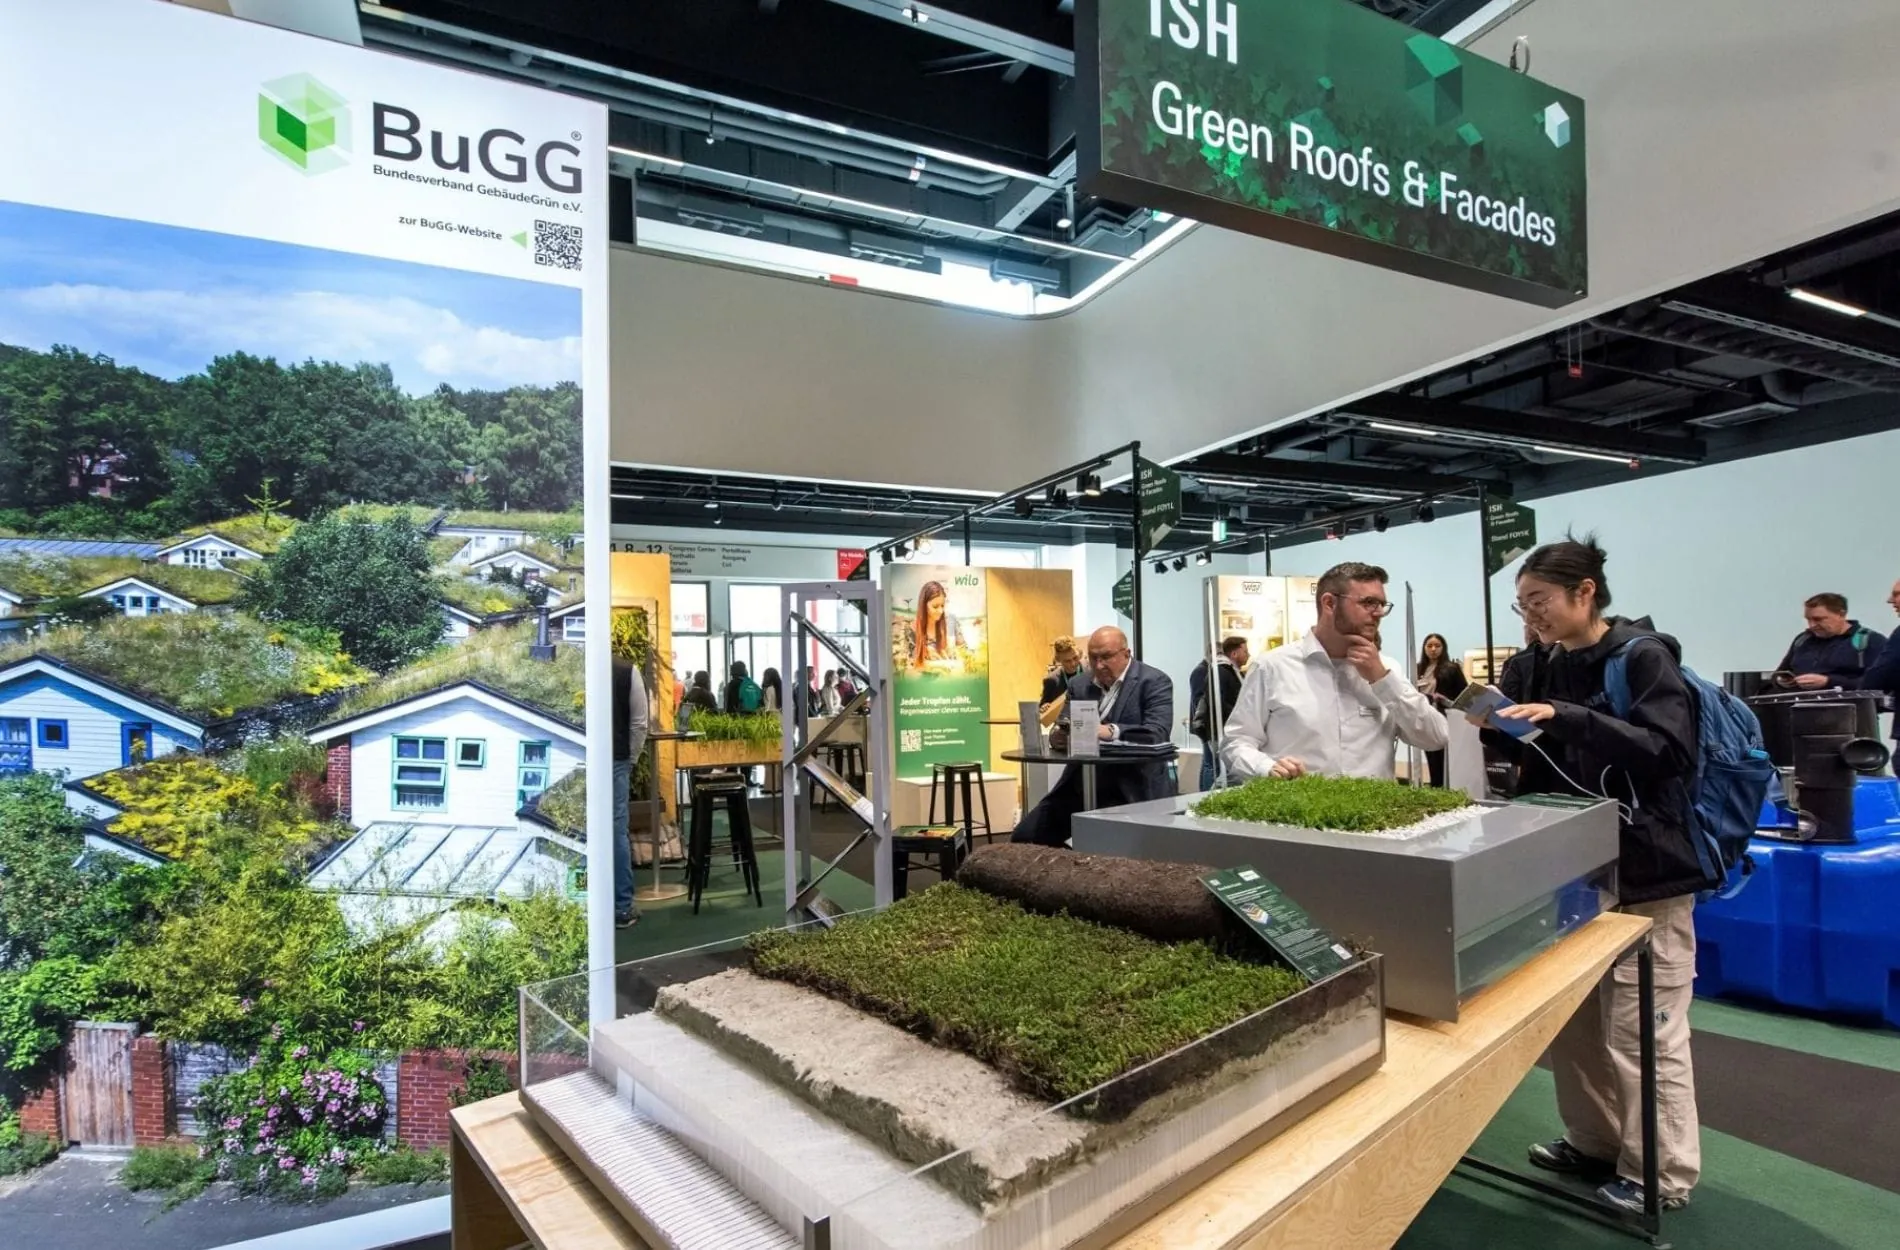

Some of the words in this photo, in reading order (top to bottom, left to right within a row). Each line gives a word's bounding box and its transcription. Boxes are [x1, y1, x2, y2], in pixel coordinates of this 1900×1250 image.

[1150, 0, 1238, 64] ISH
[373, 101, 582, 194] BuGG
[1151, 80, 1273, 163] Green
[1290, 121, 1390, 197] Roofs
[1402, 160, 1428, 207] &
[1439, 171, 1557, 247] Facades
[373, 164, 473, 193] Bundesverband
[476, 183, 560, 209] GebäudeGrün
[562, 202, 584, 214] e.V.
[398, 215, 417, 226] zur
[420, 217, 503, 241] BuGG-Website
[1140, 468, 1153, 480] ISH
[954, 574, 979, 586] wilo
[900, 697, 920, 706] Jeder
[921, 696, 951, 706] Tropfen
